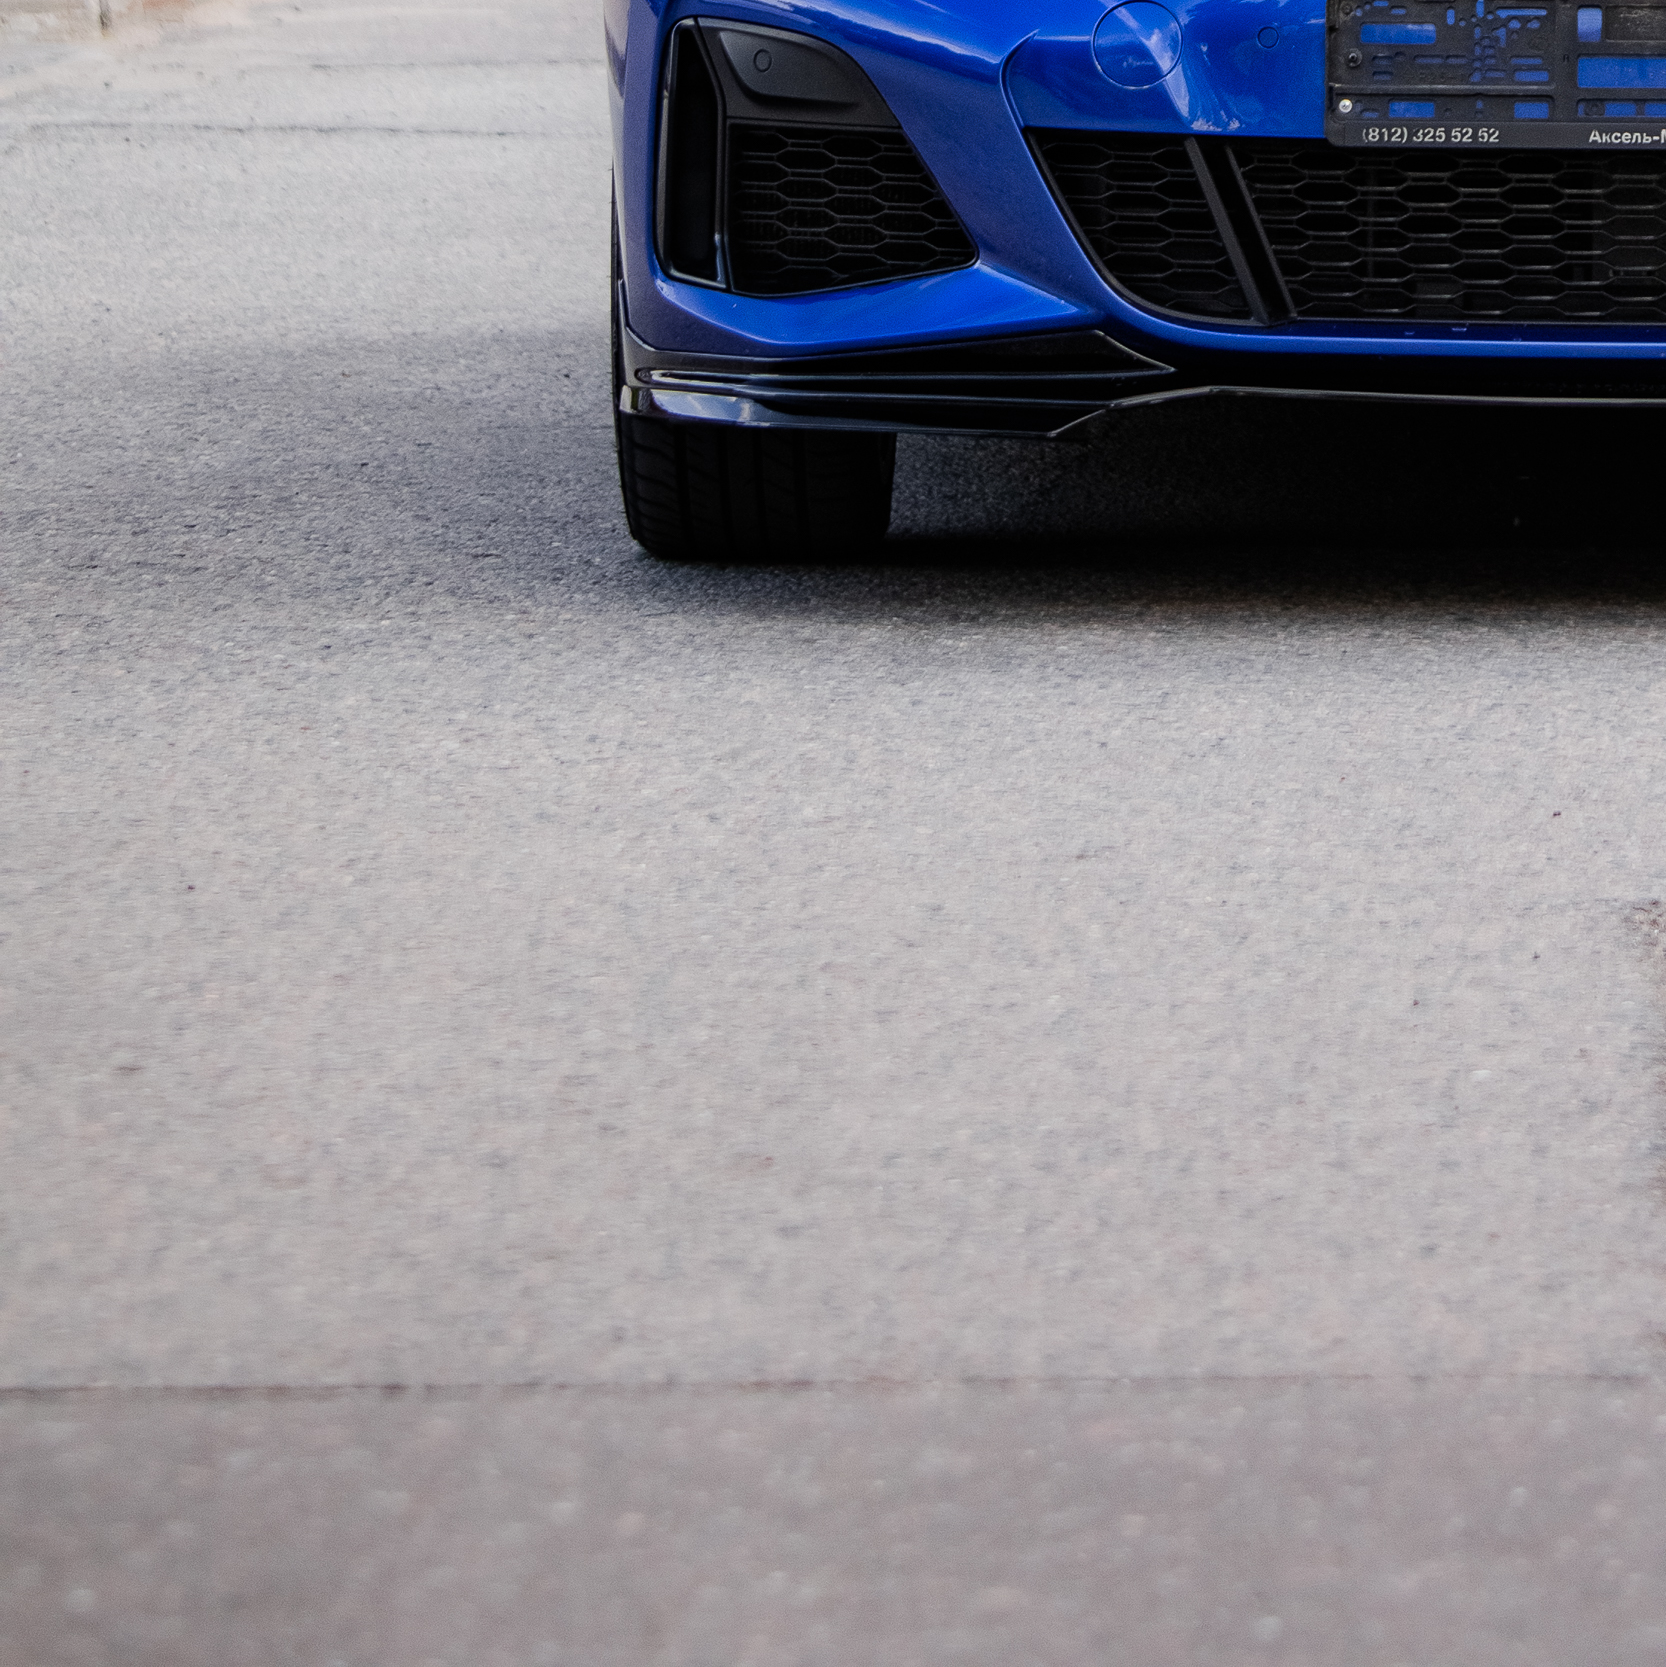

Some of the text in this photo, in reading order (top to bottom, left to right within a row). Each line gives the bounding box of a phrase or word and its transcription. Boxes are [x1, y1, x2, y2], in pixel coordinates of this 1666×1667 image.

[1362, 127, 1500, 144] (812) 325 52 52
